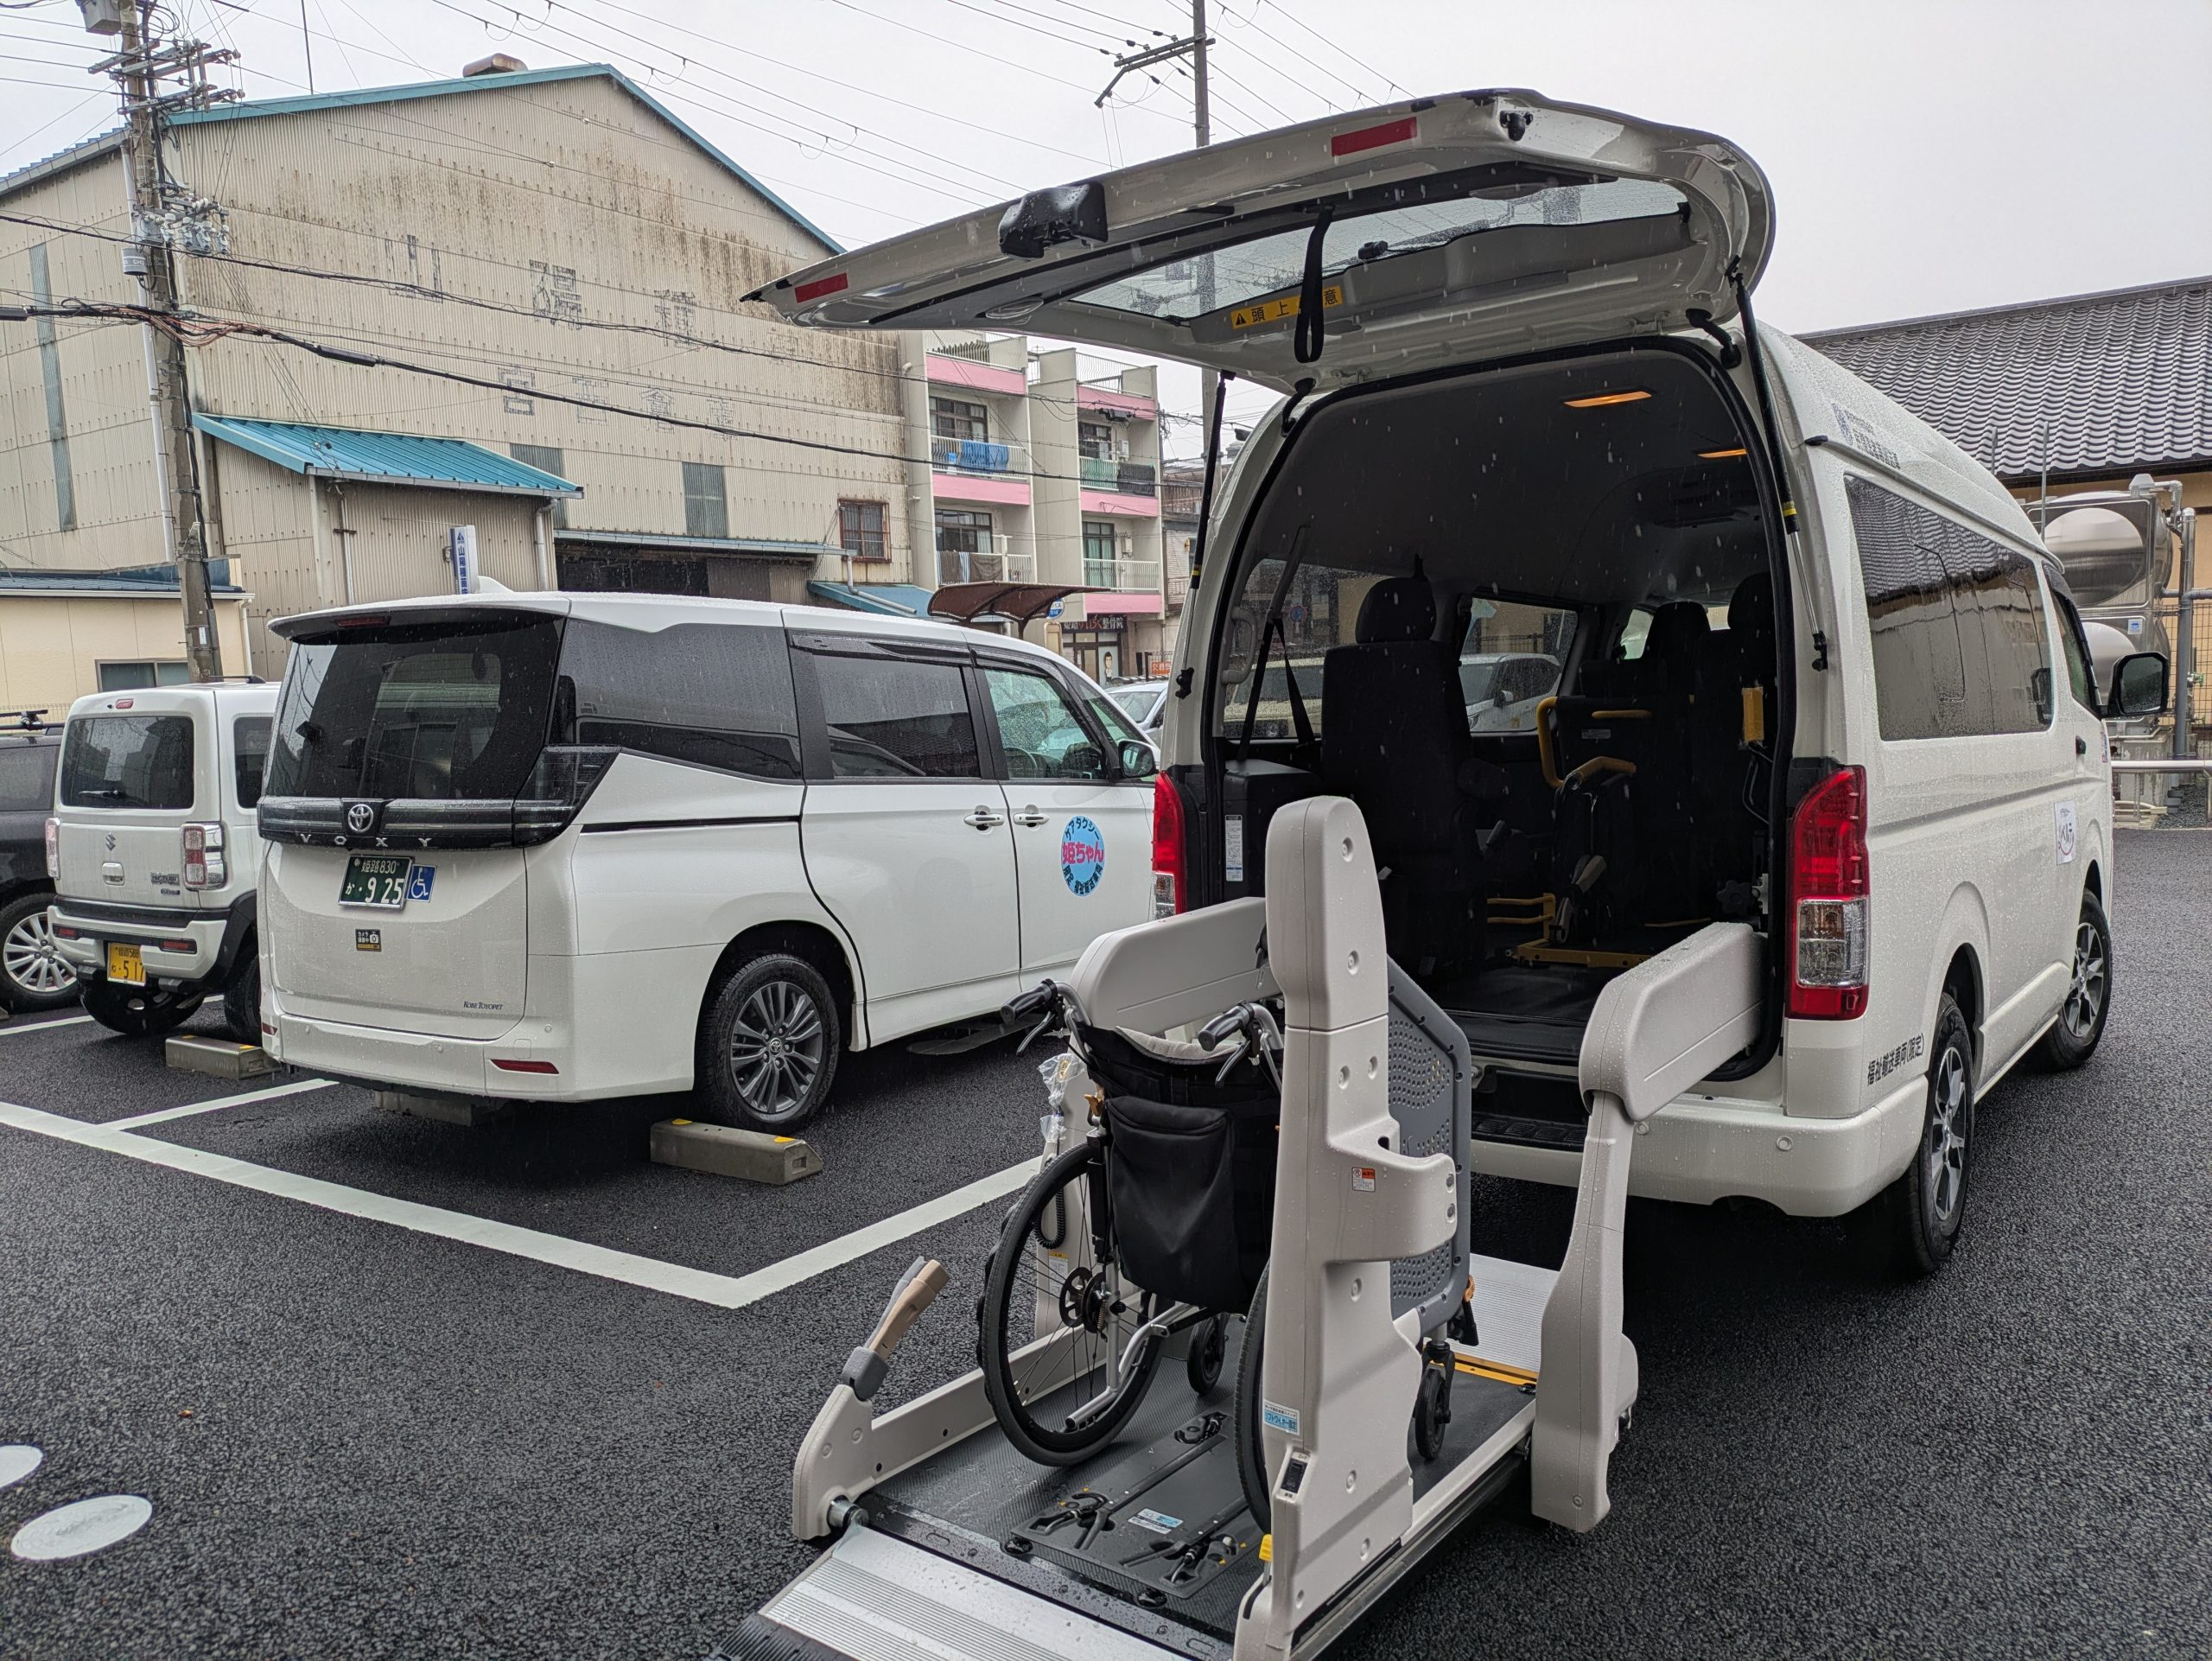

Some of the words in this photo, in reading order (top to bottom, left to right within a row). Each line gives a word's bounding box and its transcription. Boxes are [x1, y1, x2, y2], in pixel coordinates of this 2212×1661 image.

[1250, 289, 1338, 323] 頭上意
[1065, 817, 1100, 841] ケアタクシー
[1062, 842, 1104, 864] 姫ちゃん
